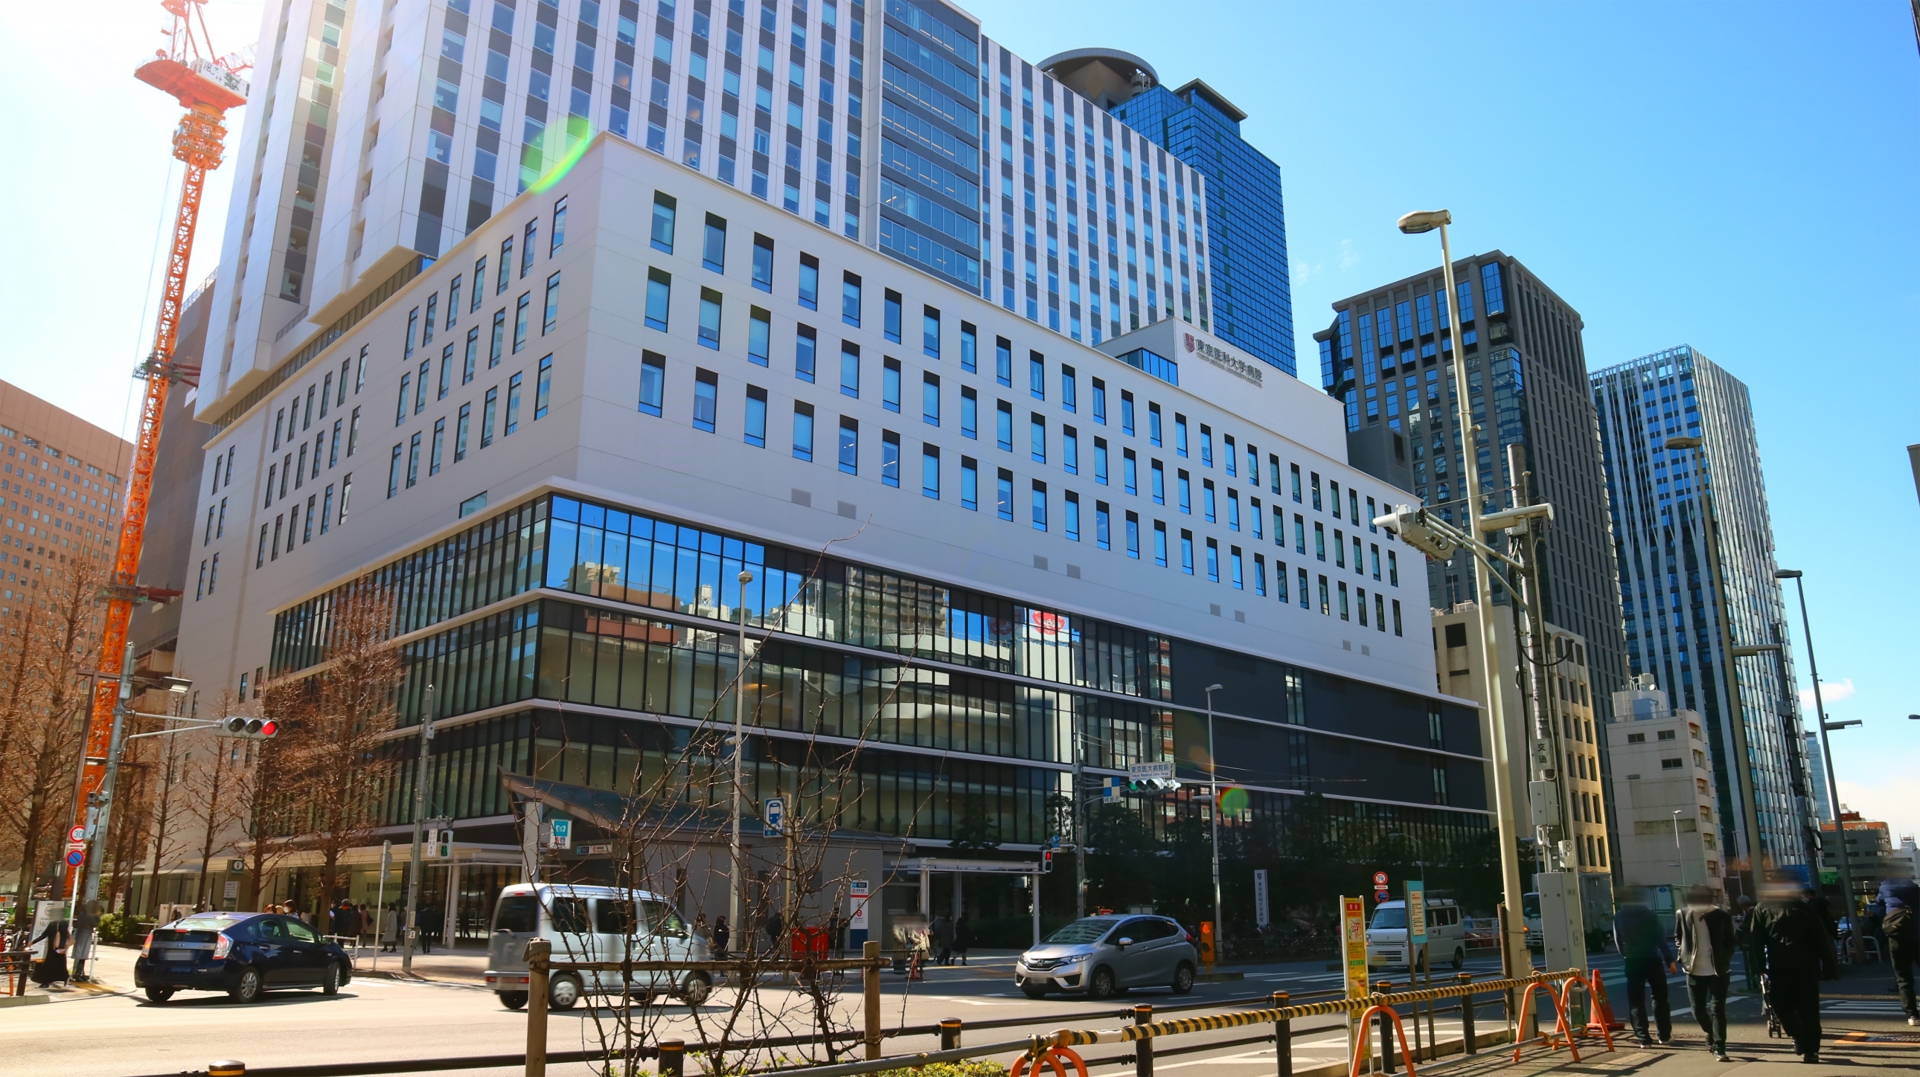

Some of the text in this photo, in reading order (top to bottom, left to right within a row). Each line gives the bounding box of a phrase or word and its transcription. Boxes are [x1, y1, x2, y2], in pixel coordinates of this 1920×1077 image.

[1196, 339, 1263, 382] 東京医科大学病院
[1537, 743, 1547, 763] 交通
[1132, 764, 1169, 773] 東京医大病院前
[74, 830, 84, 838] 30
